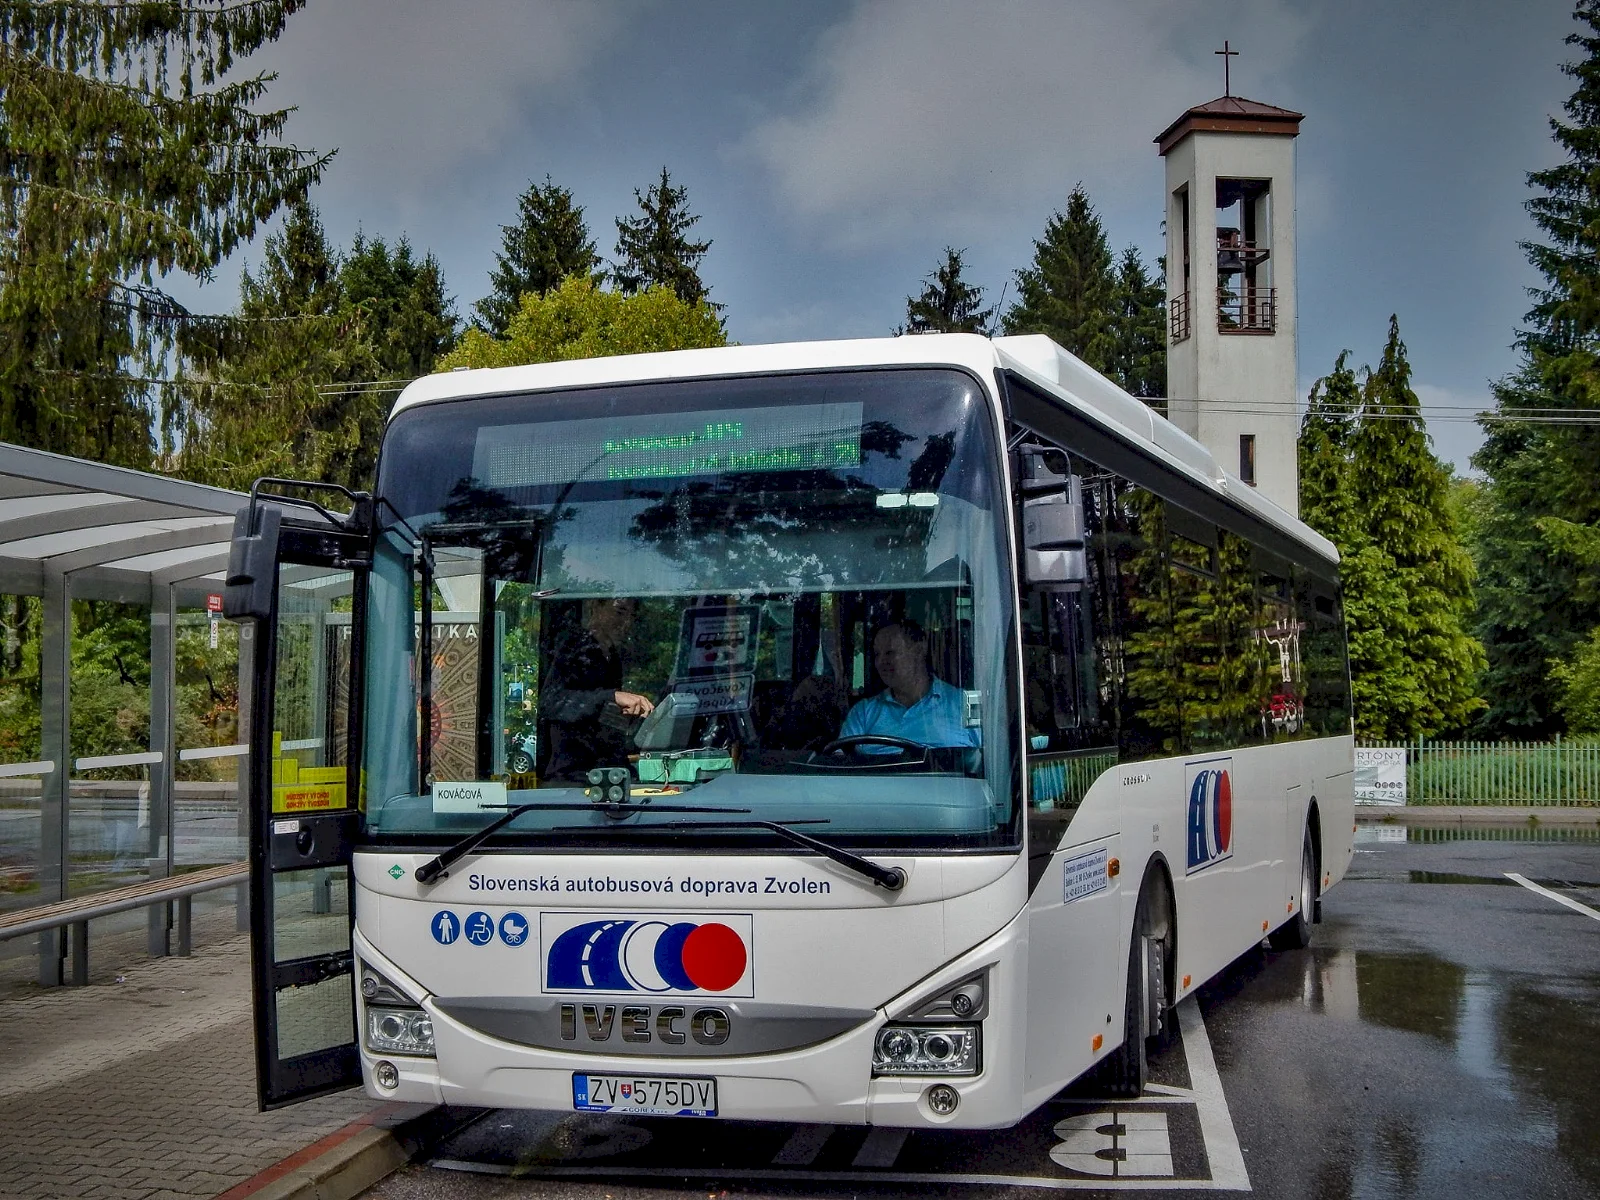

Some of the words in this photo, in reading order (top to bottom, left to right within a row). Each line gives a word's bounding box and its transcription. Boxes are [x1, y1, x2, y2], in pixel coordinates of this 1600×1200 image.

[438, 788, 482, 799] KOVÁČOVÁ
[1381, 790, 1403, 798] 754
[468, 874, 560, 892] Slovenská
[565, 875, 674, 893] autobusová
[680, 877, 758, 897] doprava
[764, 877, 831, 894] Zvolen
[560, 1004, 731, 1046] IVECO
[577, 1093, 587, 1101] SK
[590, 1078, 618, 1104] ZV
[633, 1080, 710, 1107] 575DV
